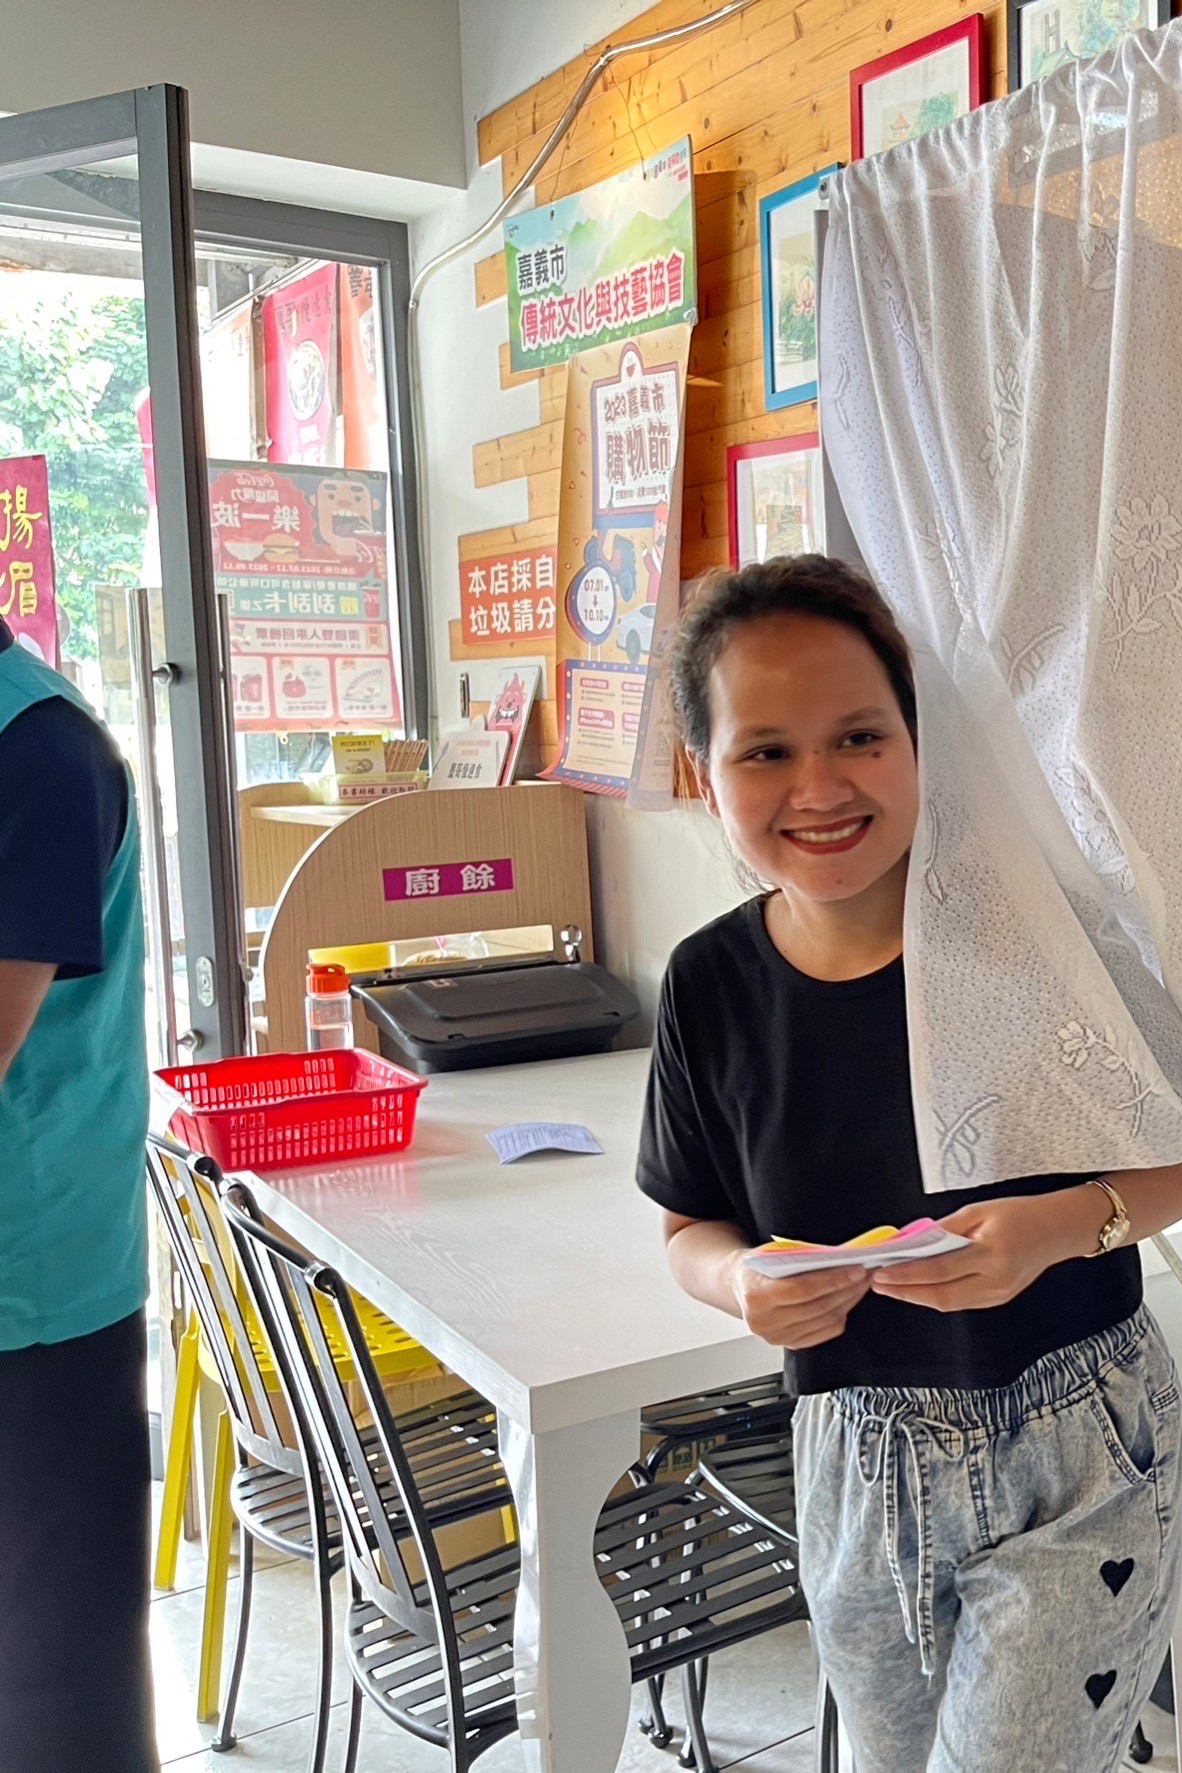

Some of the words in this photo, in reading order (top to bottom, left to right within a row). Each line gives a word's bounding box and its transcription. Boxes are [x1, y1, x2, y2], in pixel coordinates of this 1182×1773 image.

[518, 245, 564, 290] 嘉義市
[522, 253, 682, 346] 傳統文化與技藝協會
[606, 421, 670, 483] 購物節
[405, 863, 495, 896] 廚餘
